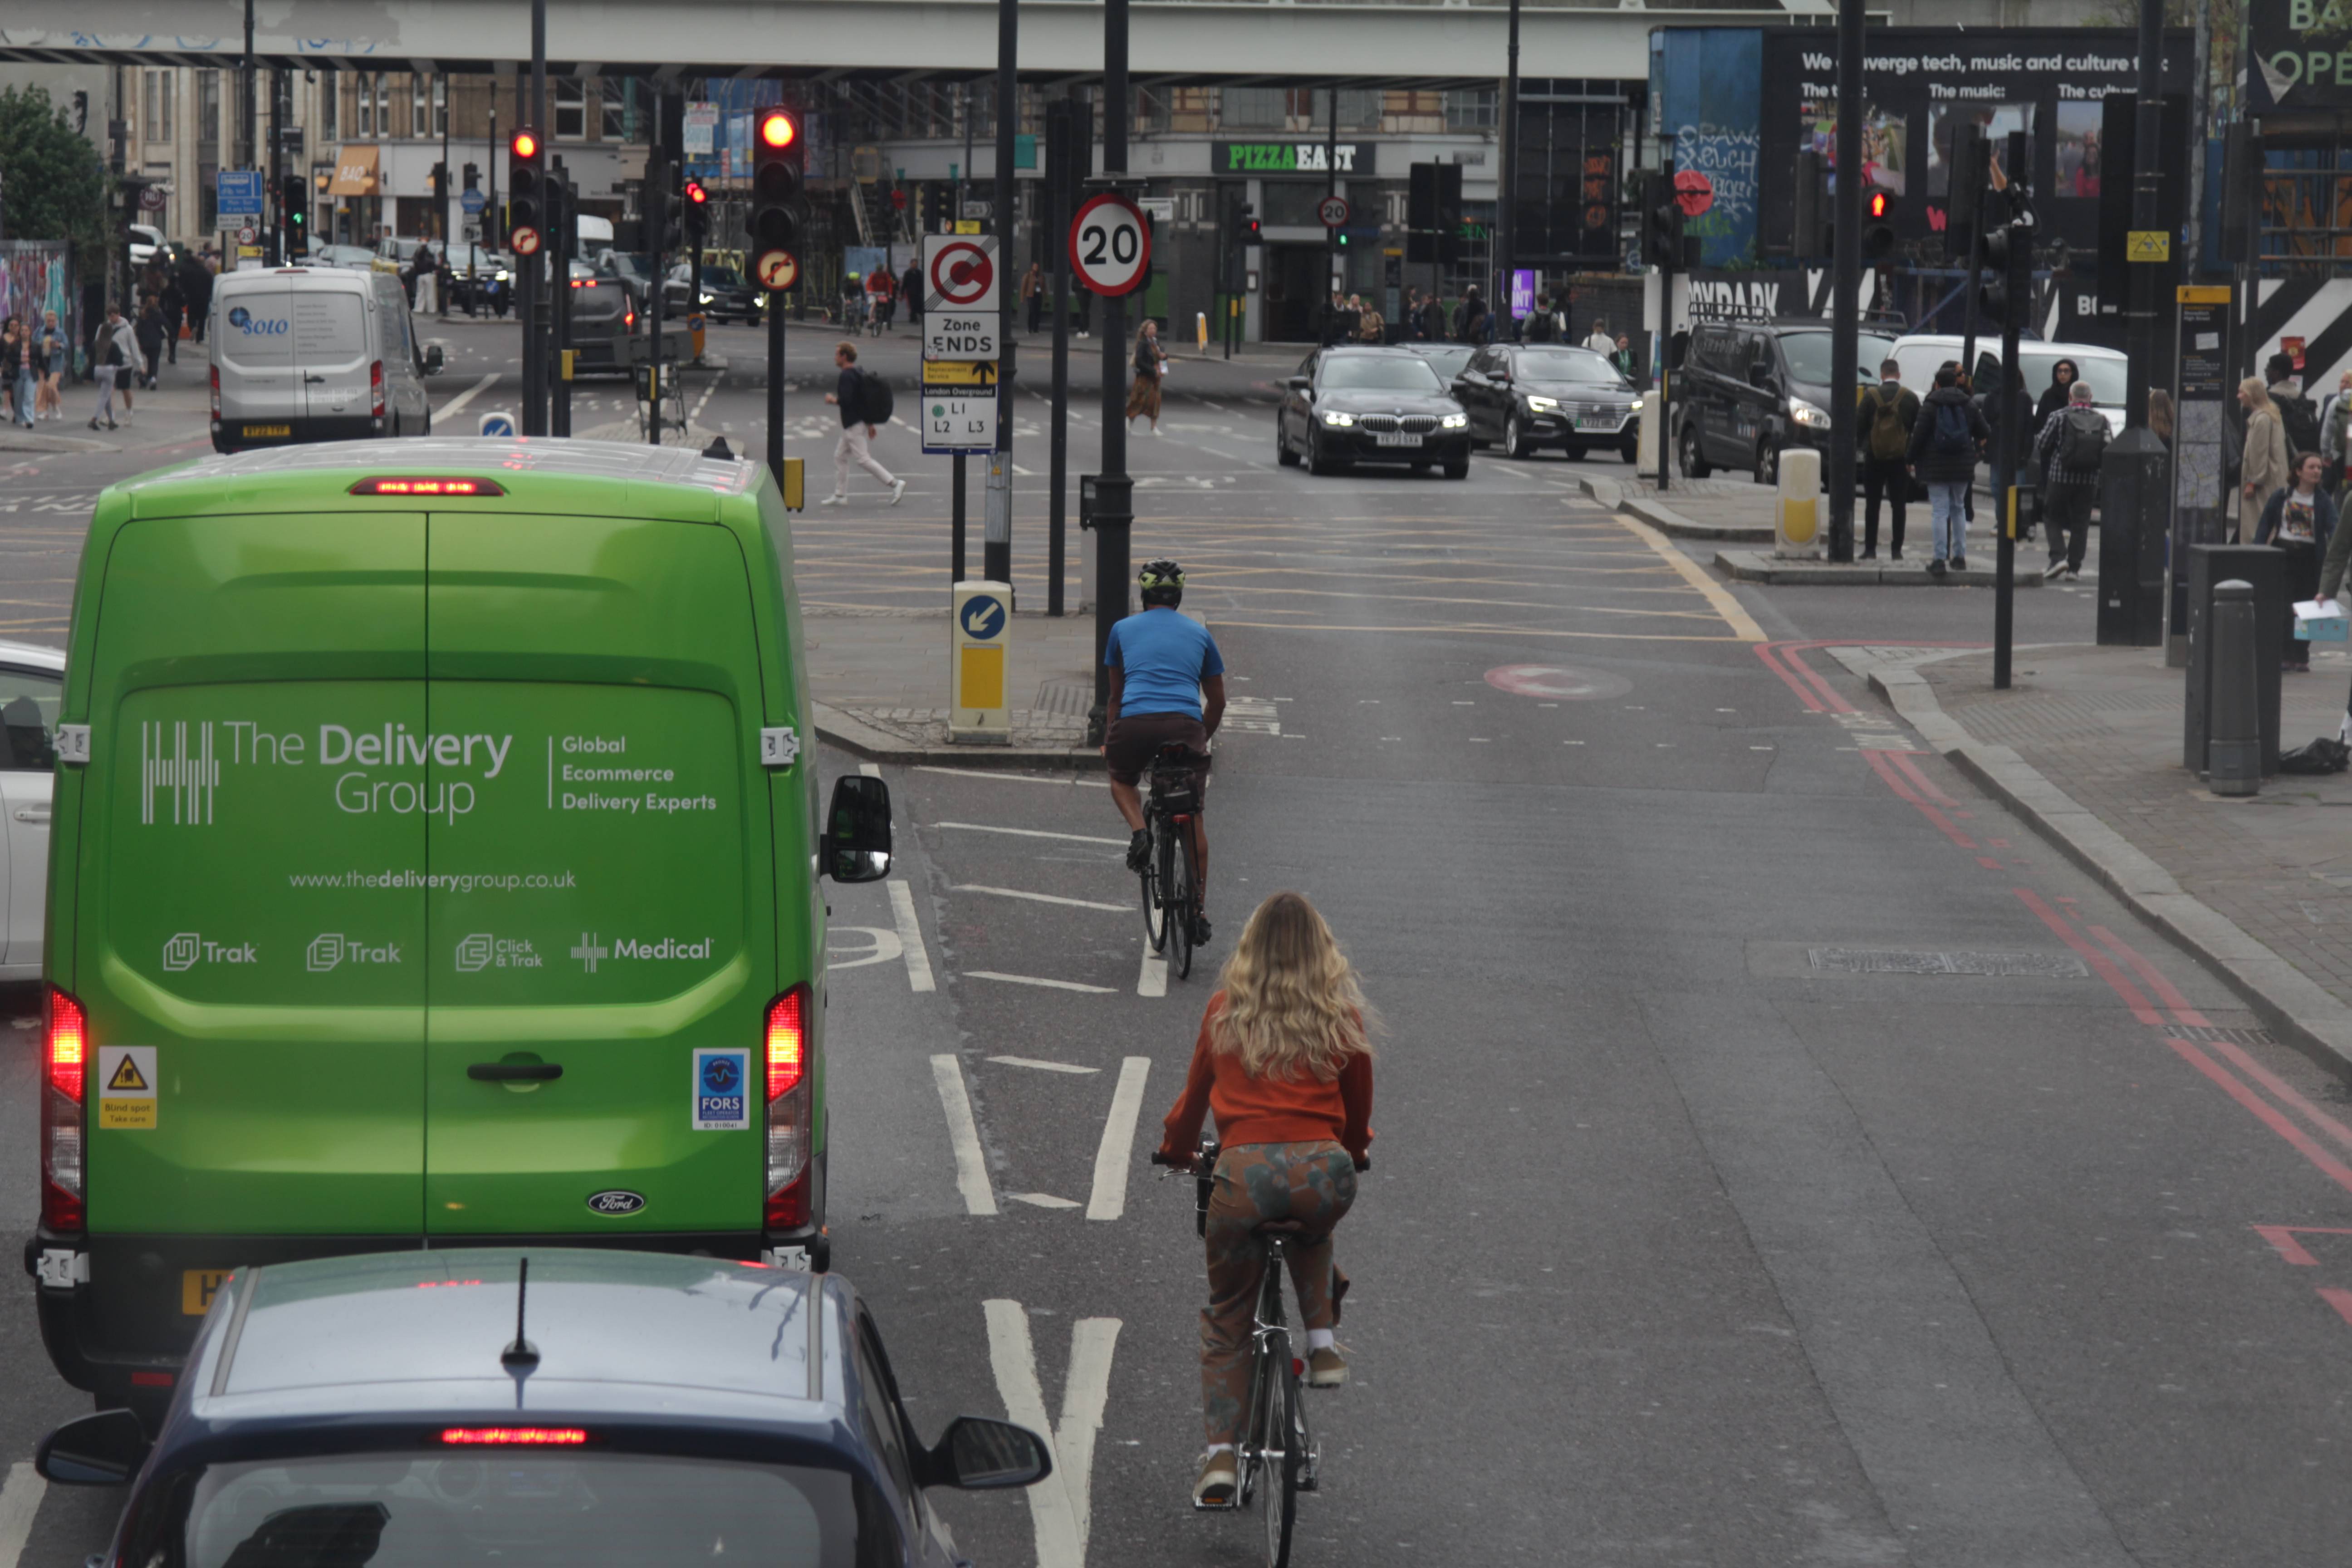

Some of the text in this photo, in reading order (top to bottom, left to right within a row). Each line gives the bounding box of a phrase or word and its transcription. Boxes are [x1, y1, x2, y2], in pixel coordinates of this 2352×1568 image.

[1802, 53, 1832, 70] We
[1922, 54, 1966, 73] tech,
[1970, 54, 2022, 70] music
[2026, 54, 2062, 70] and
[2065, 54, 2129, 71] culture
[1801, 83, 1828, 97] The
[1929, 83, 2005, 98] The music:
[2058, 83, 2086, 98] The
[1325, 206, 1345, 218] 20
[1082, 224, 1138, 265] 20
[243, 319, 288, 335] SOLO
[943, 318, 981, 331] Zone
[933, 337, 992, 352] ENDS
[952, 387, 993, 397] Overground
[935, 421, 984, 432] L2 L3
[222, 721, 513, 779] The Delivery
[562, 735, 626, 753] Global
[562, 764, 674, 782] Ecommerce
[335, 772, 475, 826] Group
[562, 792, 717, 813] Delivery Experts
[289, 869, 576, 892] www.thedeliverygroup.co.uk
[203, 941, 257, 963] Trak
[347, 942, 402, 963] Trak
[496, 939, 533, 953] Click
[615, 937, 710, 960] Medical
[496, 954, 543, 968] & Trak
[131, 1105, 151, 1113] spot
[702, 1097, 740, 1110] FORS
[598, 1193, 634, 1210] Ford
